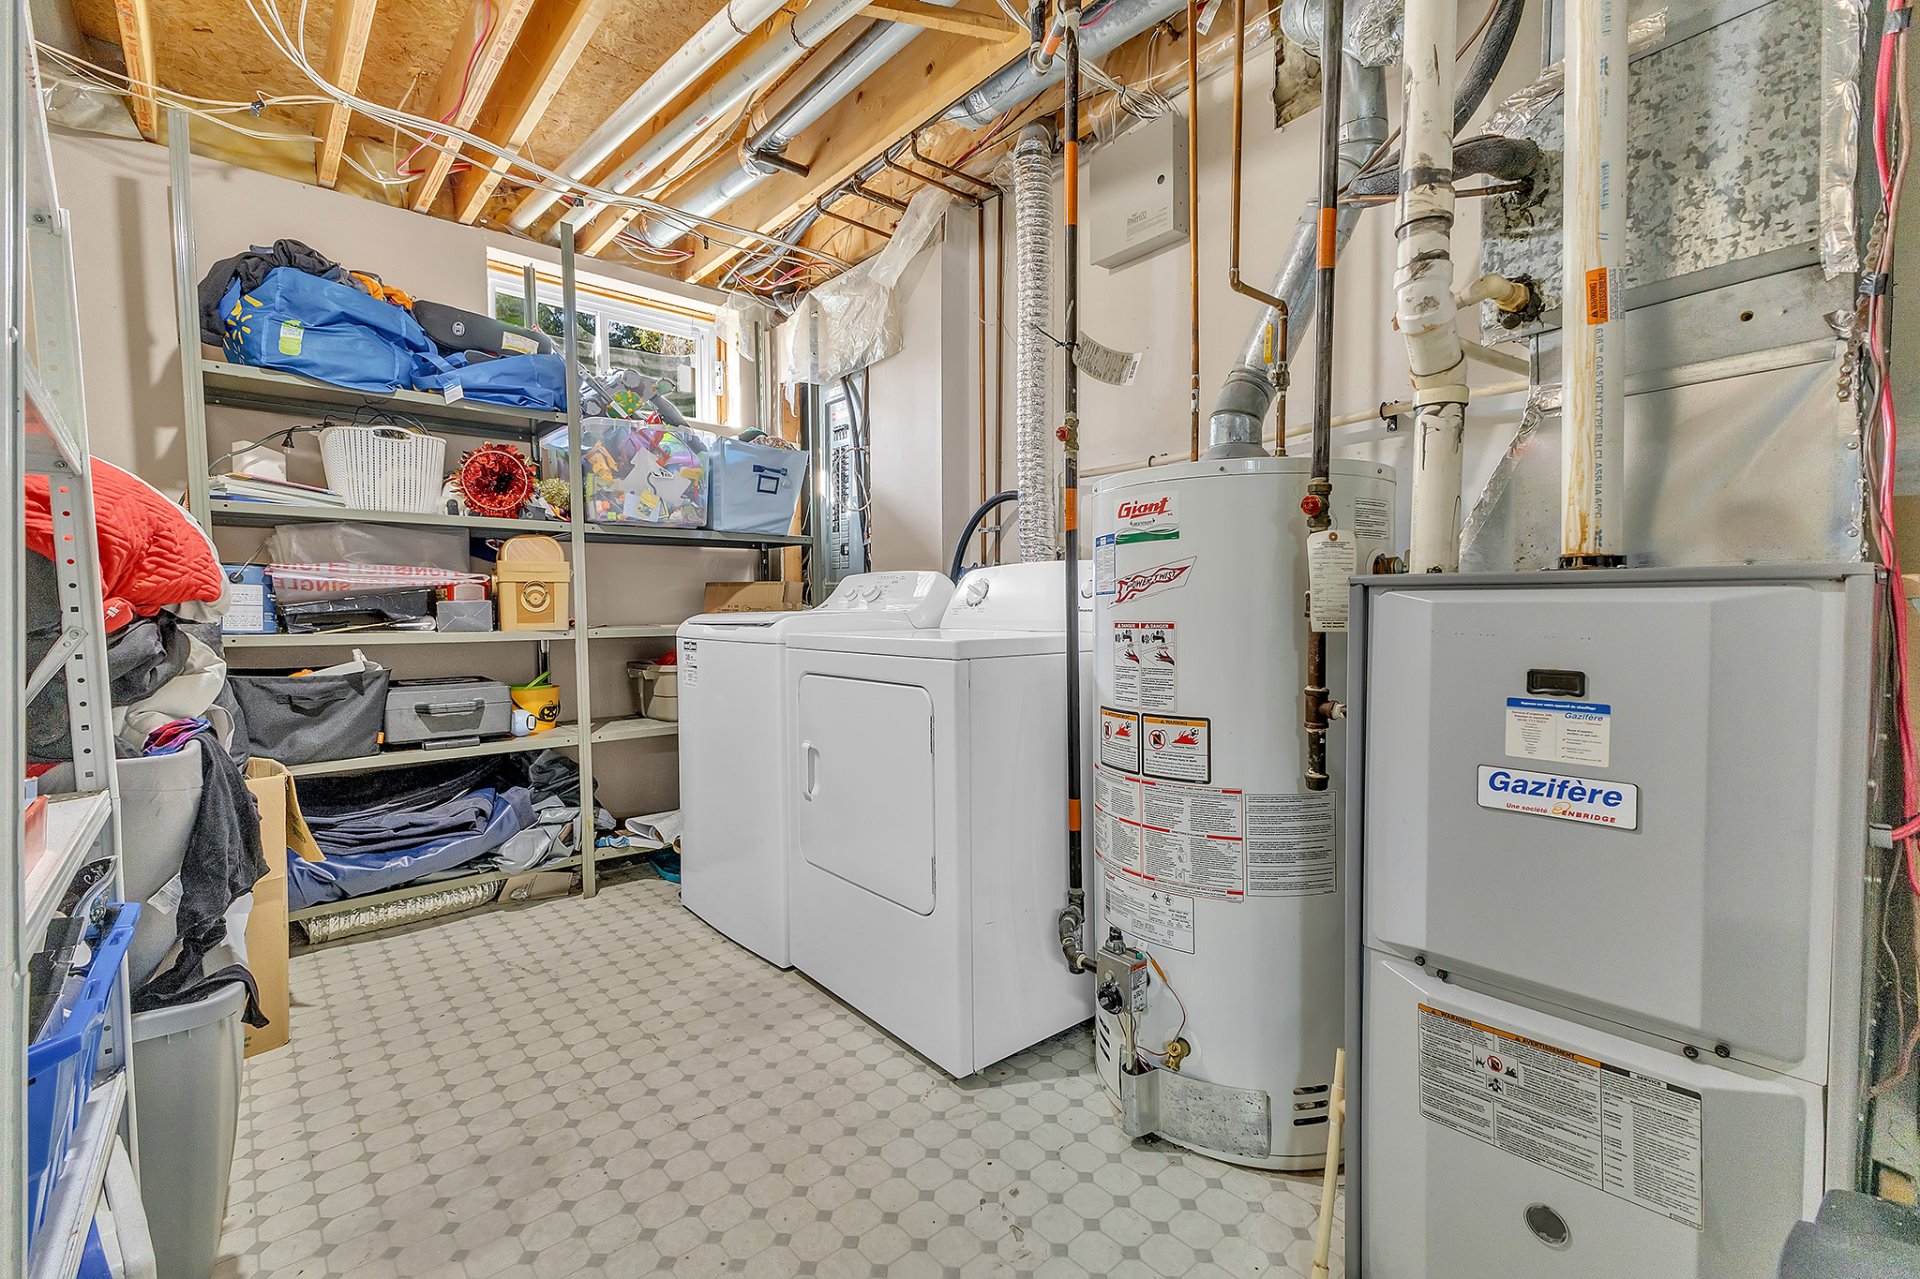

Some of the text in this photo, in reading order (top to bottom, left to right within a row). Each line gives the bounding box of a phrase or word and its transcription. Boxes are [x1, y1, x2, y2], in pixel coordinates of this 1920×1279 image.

[1590, 282, 1598, 310] WARNING
[1599, 272, 1607, 318] AVERTISSEMENT
[1596, 356, 1604, 377] GAS
[1595, 380, 1604, 404] VENT
[1595, 406, 1603, 432] TYPE
[1594, 433, 1602, 447] BH
[1594, 450, 1602, 482] CLASS
[1118, 496, 1172, 519] Giant
[1126, 570, 1176, 591] POWER TWIST
[1564, 712, 1603, 722] Gazifère
[1488, 771, 1623, 807] Gazifère
[1506, 802, 1616, 824] Une société ENBRIDGE
[1440, 1012, 1472, 1026] WARNING
[1522, 1038, 1575, 1059] AVERTISSEMENT
[1637, 1075, 1661, 1086] SERVICE
